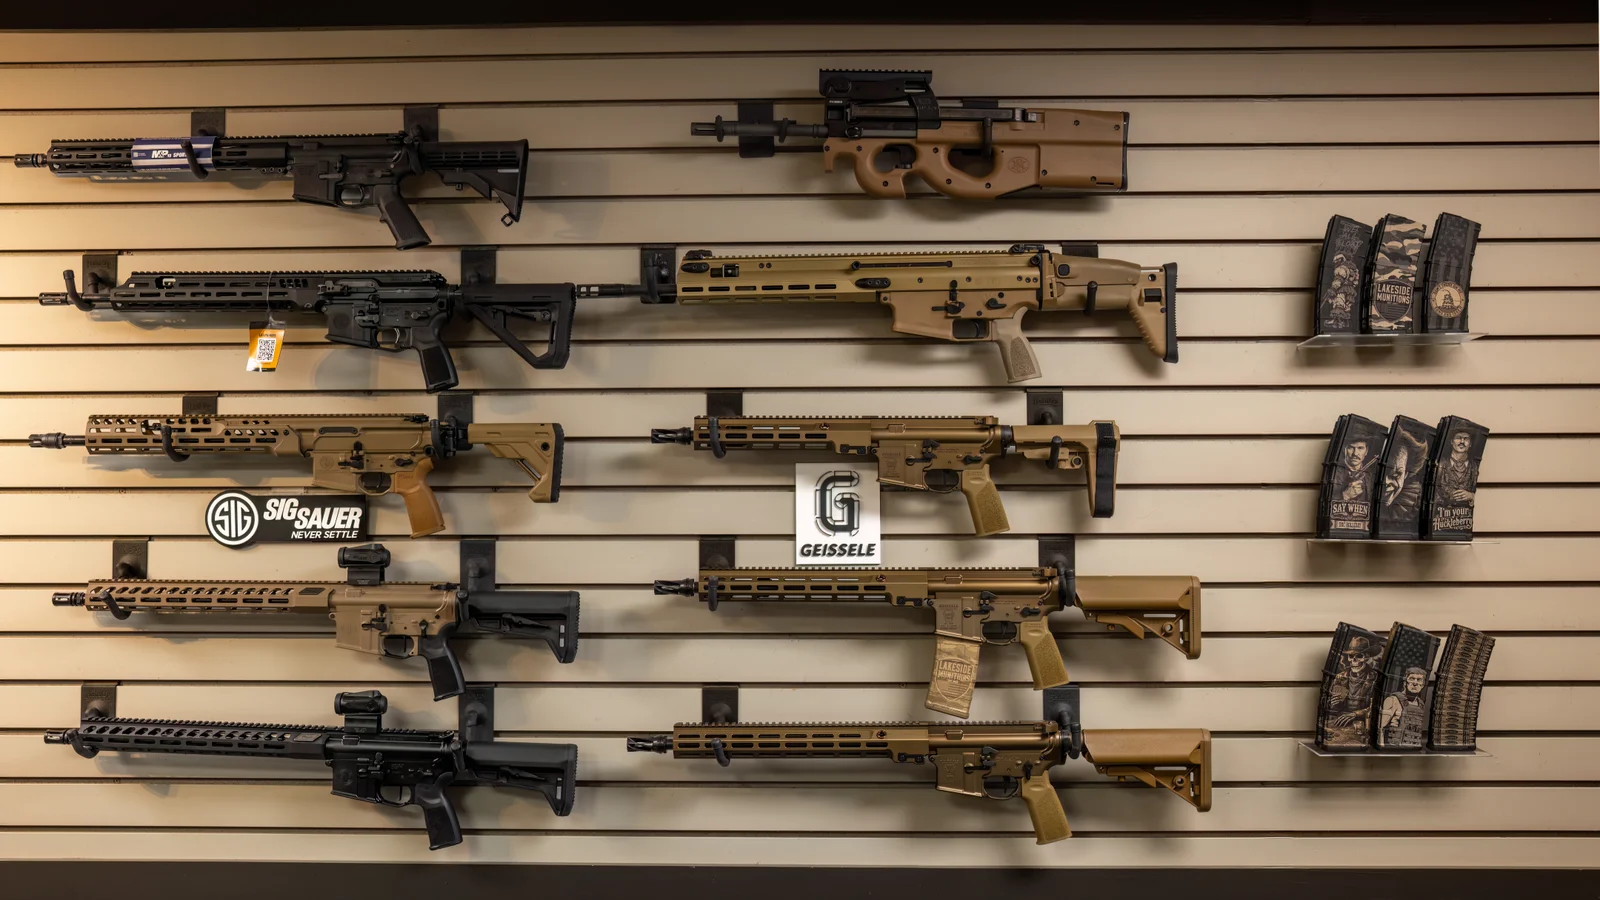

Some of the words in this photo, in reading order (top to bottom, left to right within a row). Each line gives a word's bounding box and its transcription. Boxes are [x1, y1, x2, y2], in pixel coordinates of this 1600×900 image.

[1377, 283, 1411, 296] LAKESIDE
[1376, 292, 1411, 305] MUNITIONS
[263, 498, 299, 521] SIG
[294, 507, 363, 530] SAUER
[1332, 503, 1347, 514] SAY
[1347, 503, 1368, 516] WHEN
[1437, 506, 1451, 518] I'm
[214, 499, 252, 538] SIG
[1433, 515, 1473, 531] Huckleberry
[291, 530, 323, 539] NEVER
[323, 530, 359, 539] SETTLE
[800, 543, 877, 557] GEISSELE
[939, 660, 972, 675] LAKESIDE
